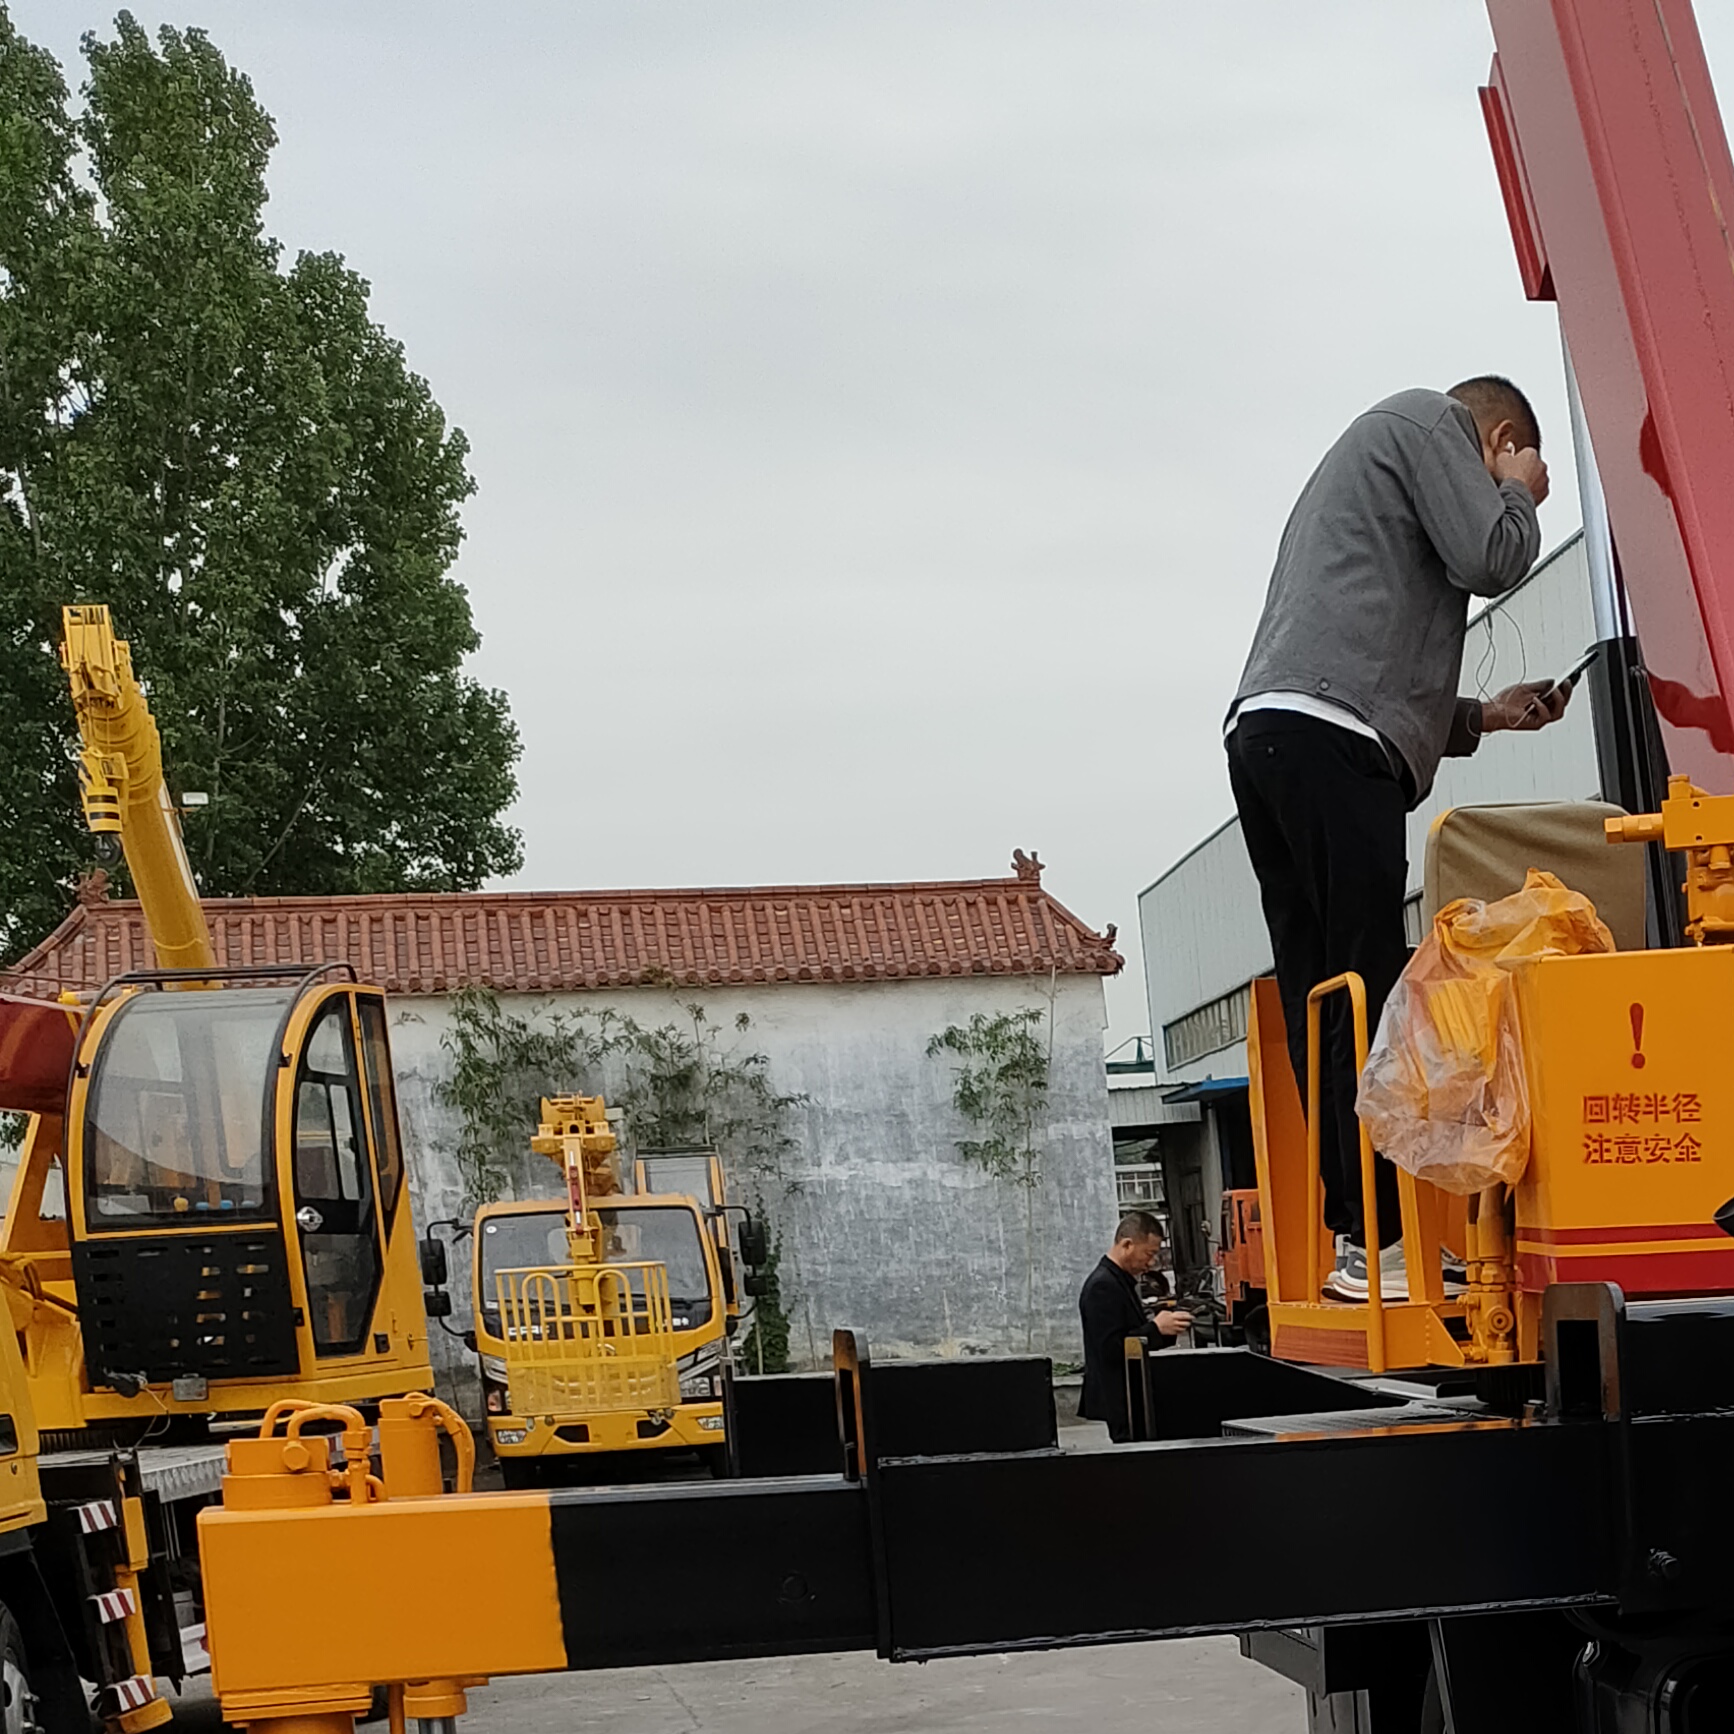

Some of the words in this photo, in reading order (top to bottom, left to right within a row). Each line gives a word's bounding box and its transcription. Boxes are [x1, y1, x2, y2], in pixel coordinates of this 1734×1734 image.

[1582, 1093, 1702, 1124] 回转半径
[1582, 1132, 1702, 1164] 注意安全
